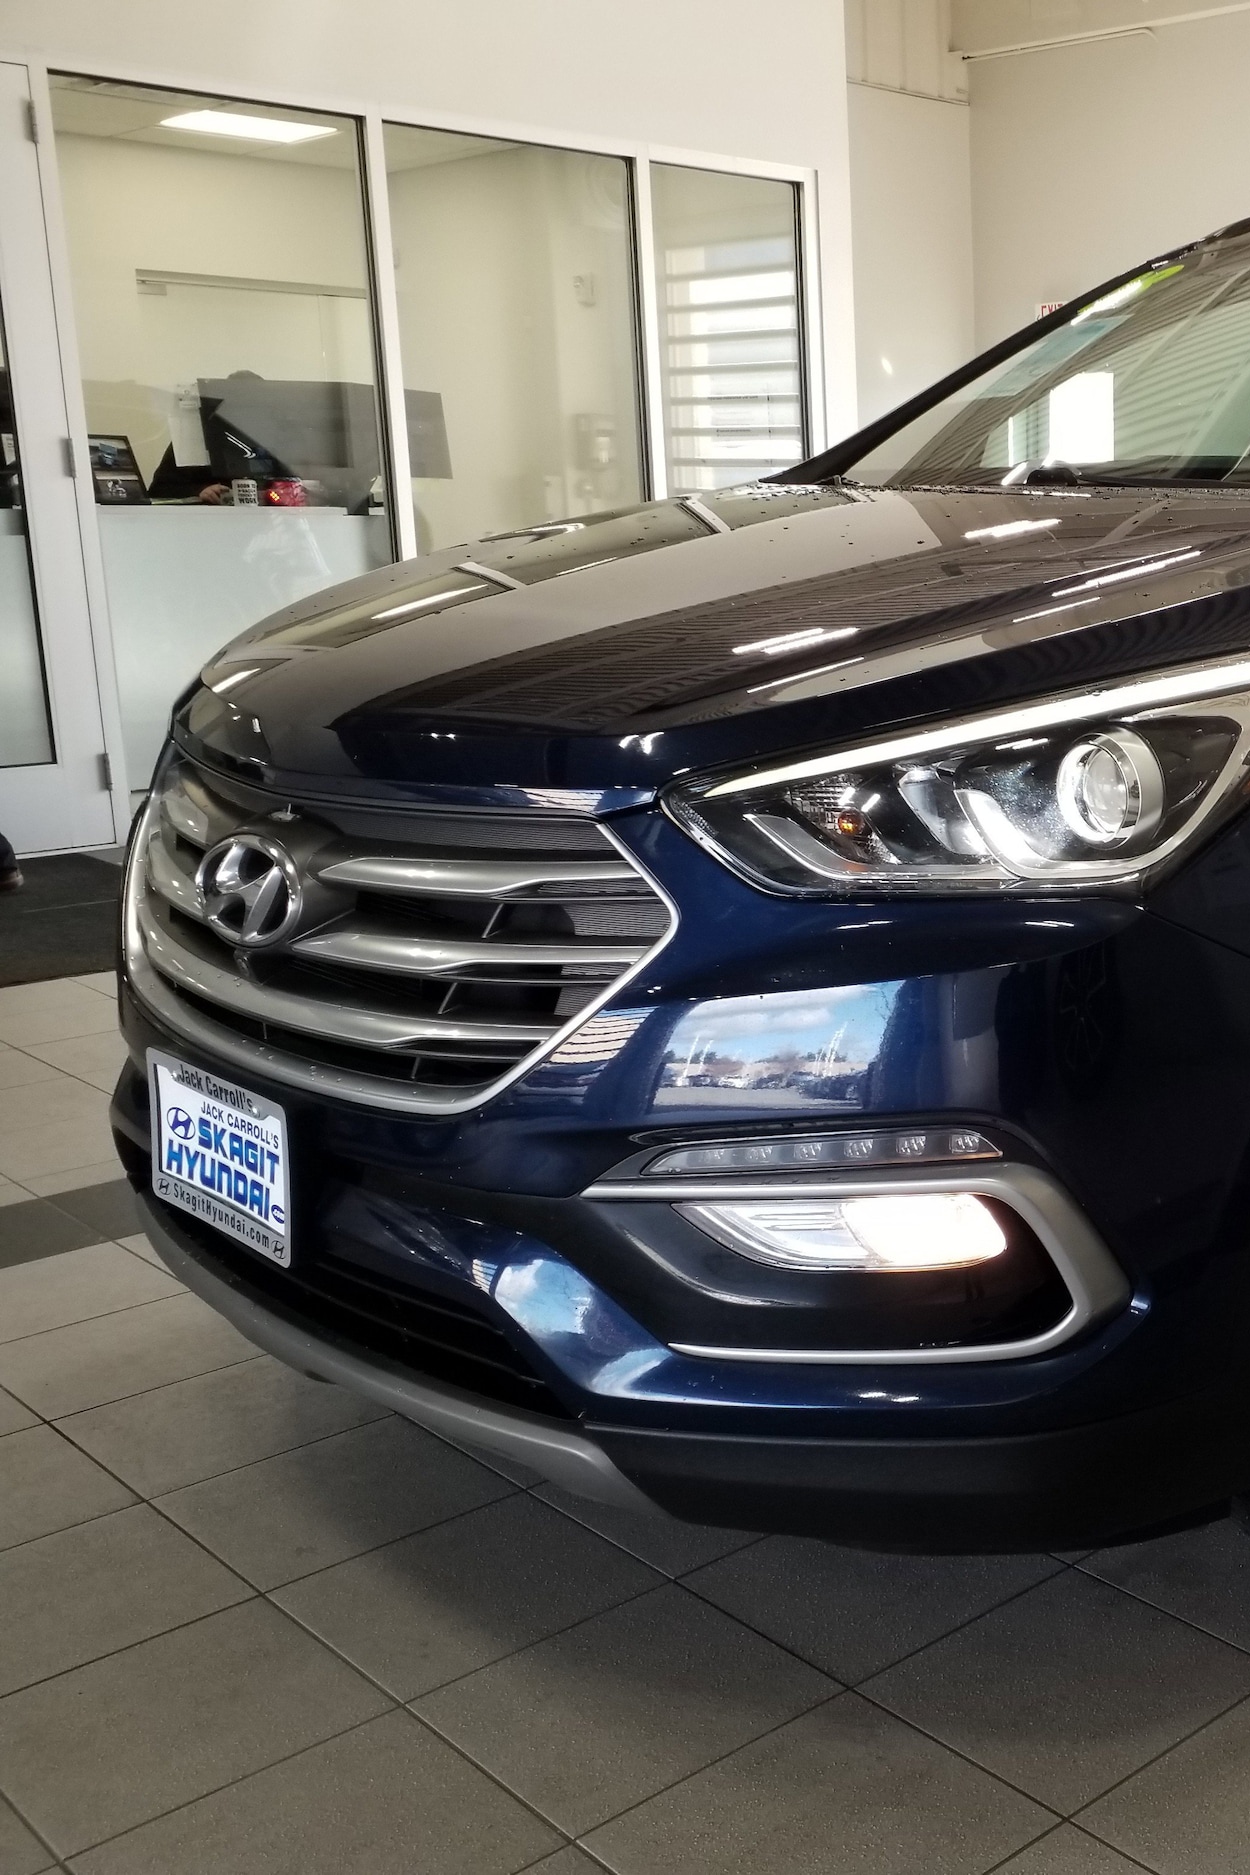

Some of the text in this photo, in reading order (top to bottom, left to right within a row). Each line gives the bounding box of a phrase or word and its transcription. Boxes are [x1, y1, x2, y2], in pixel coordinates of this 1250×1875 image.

[1041, 303, 1063, 318] EX
[177, 1064, 254, 1112] Jack Carroll's
[198, 1117, 279, 1185] SKAGIT
[200, 1101, 279, 1149] JACK CARROLL'S
[166, 1139, 270, 1222] HYUNDAI
[173, 1183, 270, 1249] SkagitHyundai.com
